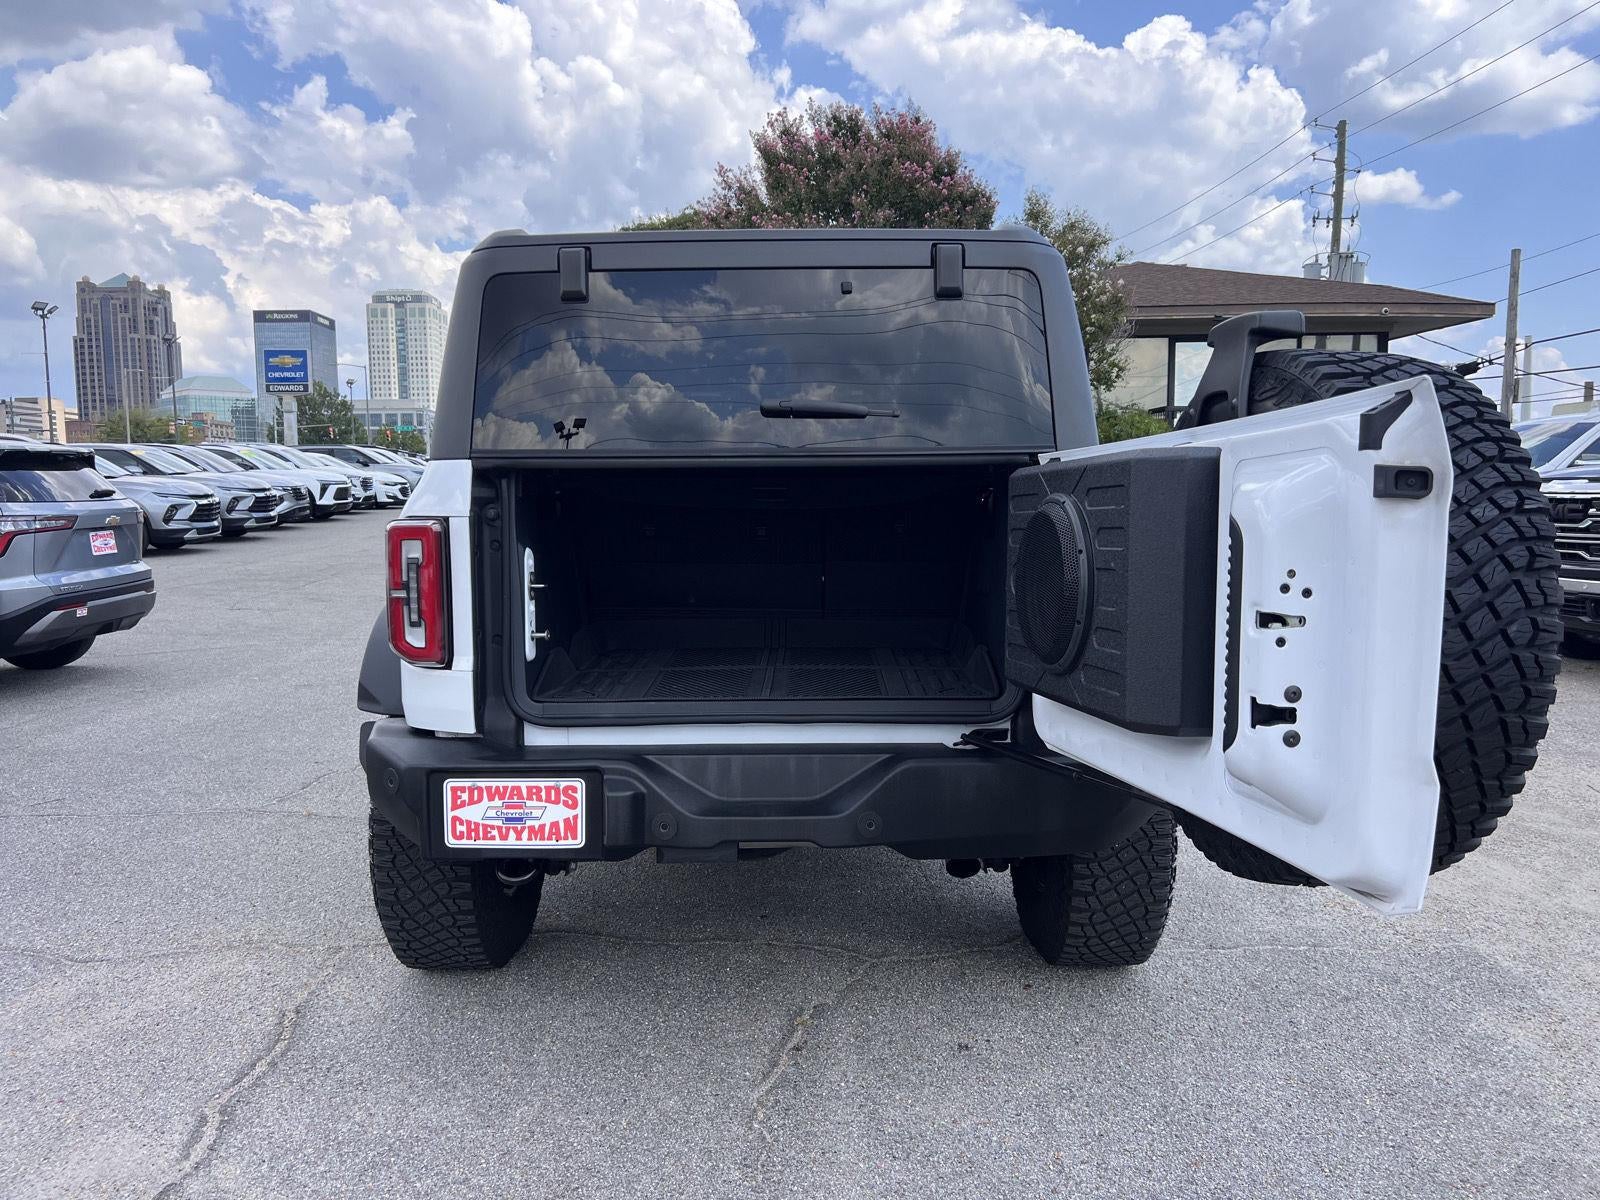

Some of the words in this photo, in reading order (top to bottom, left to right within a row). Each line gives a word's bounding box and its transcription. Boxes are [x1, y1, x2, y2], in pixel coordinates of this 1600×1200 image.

[385, 295, 405, 303] Shipt
[268, 371, 304, 379] CHEVROLET
[269, 384, 304, 392] EDWARDS
[450, 784, 579, 812] EDWARDS
[450, 813, 579, 842] CHEVYMAN
